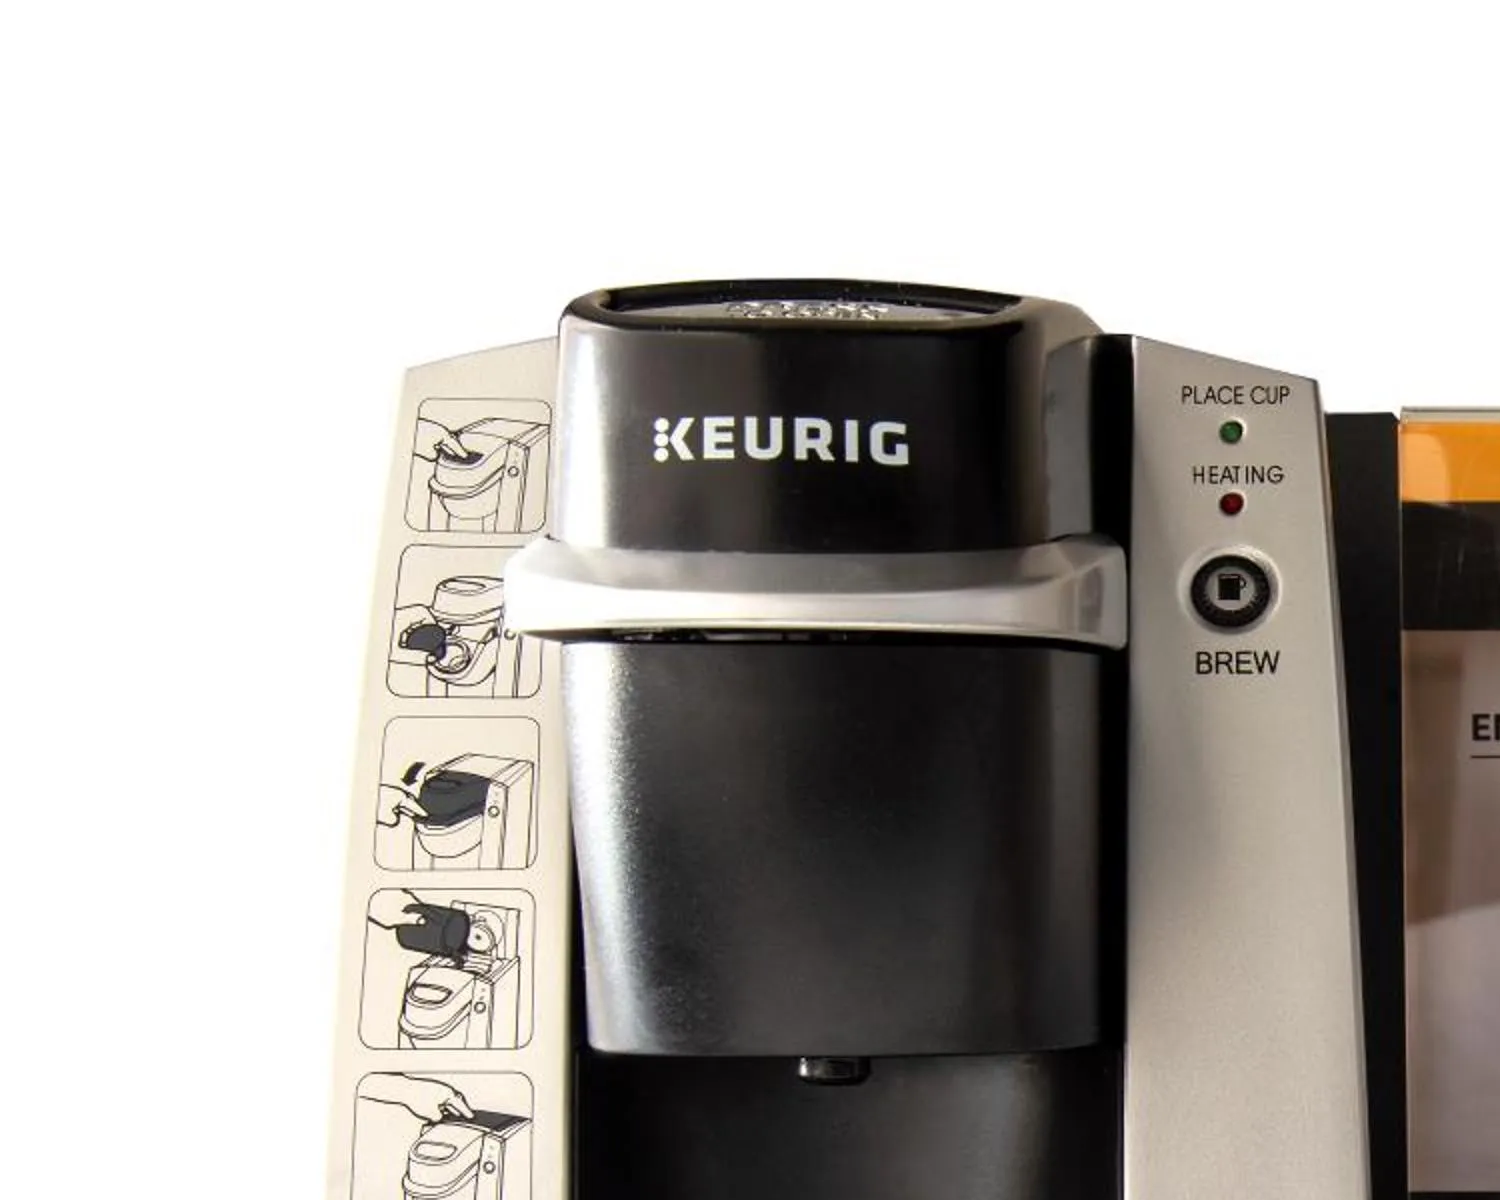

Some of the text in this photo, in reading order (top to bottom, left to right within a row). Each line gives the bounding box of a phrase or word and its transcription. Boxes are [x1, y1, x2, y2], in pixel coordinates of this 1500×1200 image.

[1181, 386, 1291, 406] PLACE CUP
[653, 415, 910, 466] KEURIG
[1191, 465, 1285, 485] HEATING
[1195, 651, 1281, 675] BREW
